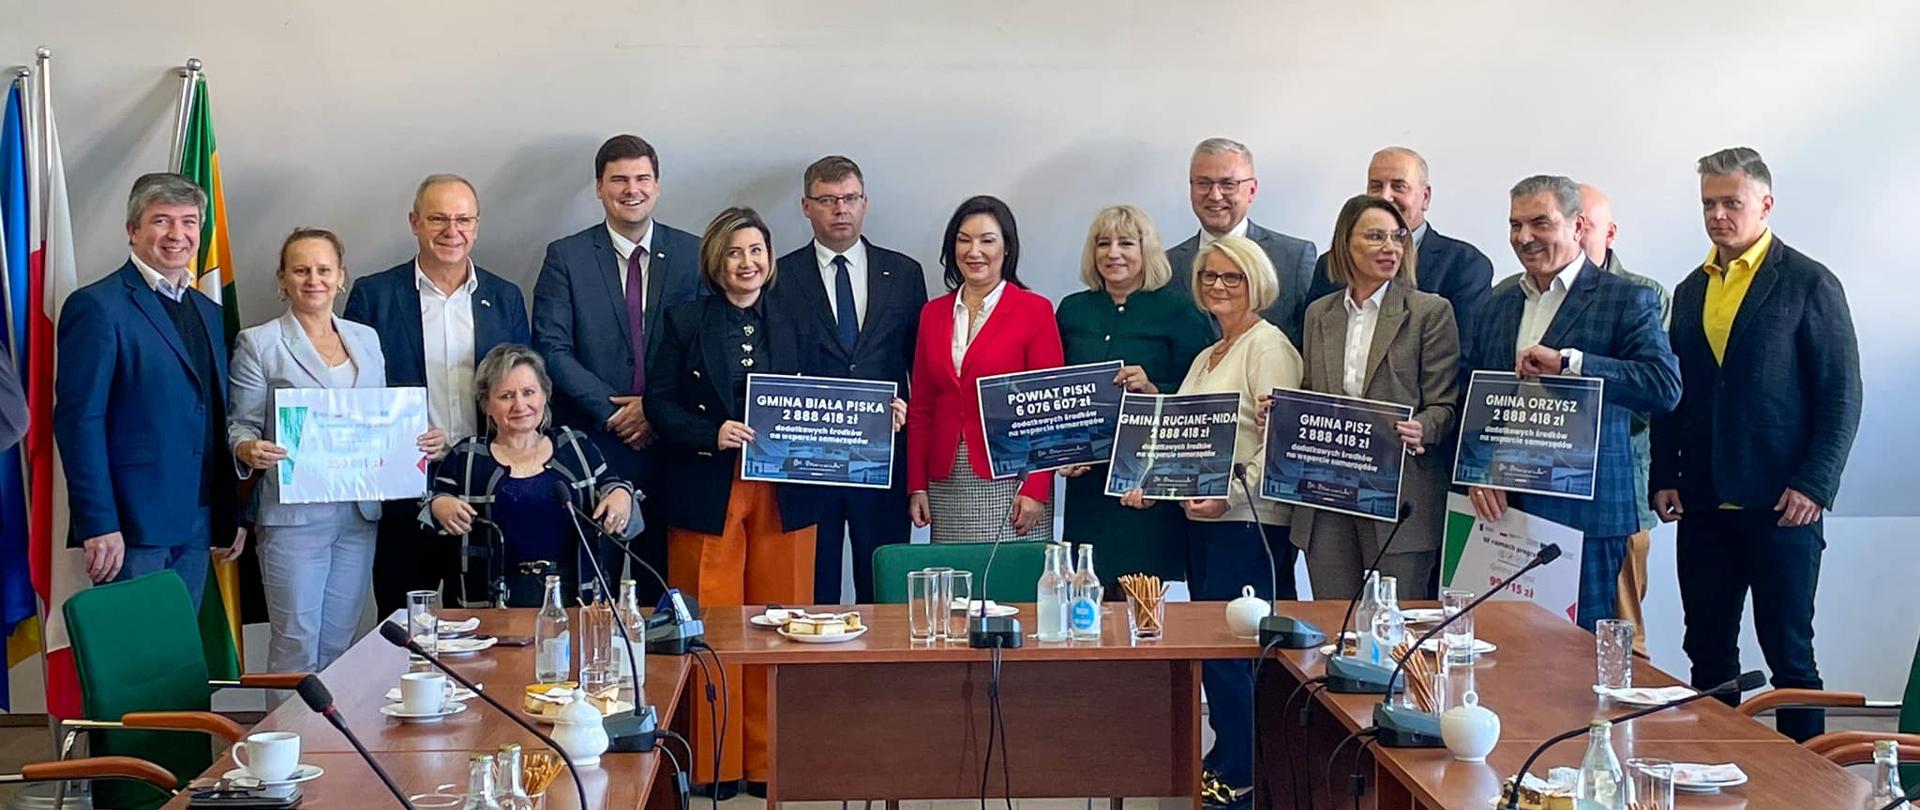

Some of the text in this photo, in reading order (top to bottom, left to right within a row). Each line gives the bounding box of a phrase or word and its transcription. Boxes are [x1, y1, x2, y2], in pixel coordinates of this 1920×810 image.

[1008, 384, 1095, 405] POWIAT PISKI
[757, 395, 884, 413] GMINA BIAŁA PISKA
[1016, 396, 1091, 416] 6 076 607 zł
[1486, 395, 1577, 412] GMINA ORZYSZ
[783, 410, 858, 424] 2 888 418 zł
[1011, 415, 1063, 429] dodatkowych
[1121, 413, 1237, 425] GMINA RUCIANE-NIDA
[1493, 411, 1564, 426] 2 888 418 zł
[775, 425, 828, 437] dodatkowych
[1020, 425, 1054, 436] wsparcie
[1300, 414, 1372, 435] GMINA PISZ
[782, 434, 817, 442] wsparcie
[1160, 428, 1180, 438] 888
[1182, 428, 1199, 438] 418
[1201, 427, 1209, 437] zł
[1299, 428, 1370, 449] 2 888 418 zł
[1492, 540, 1516, 550] ramach
